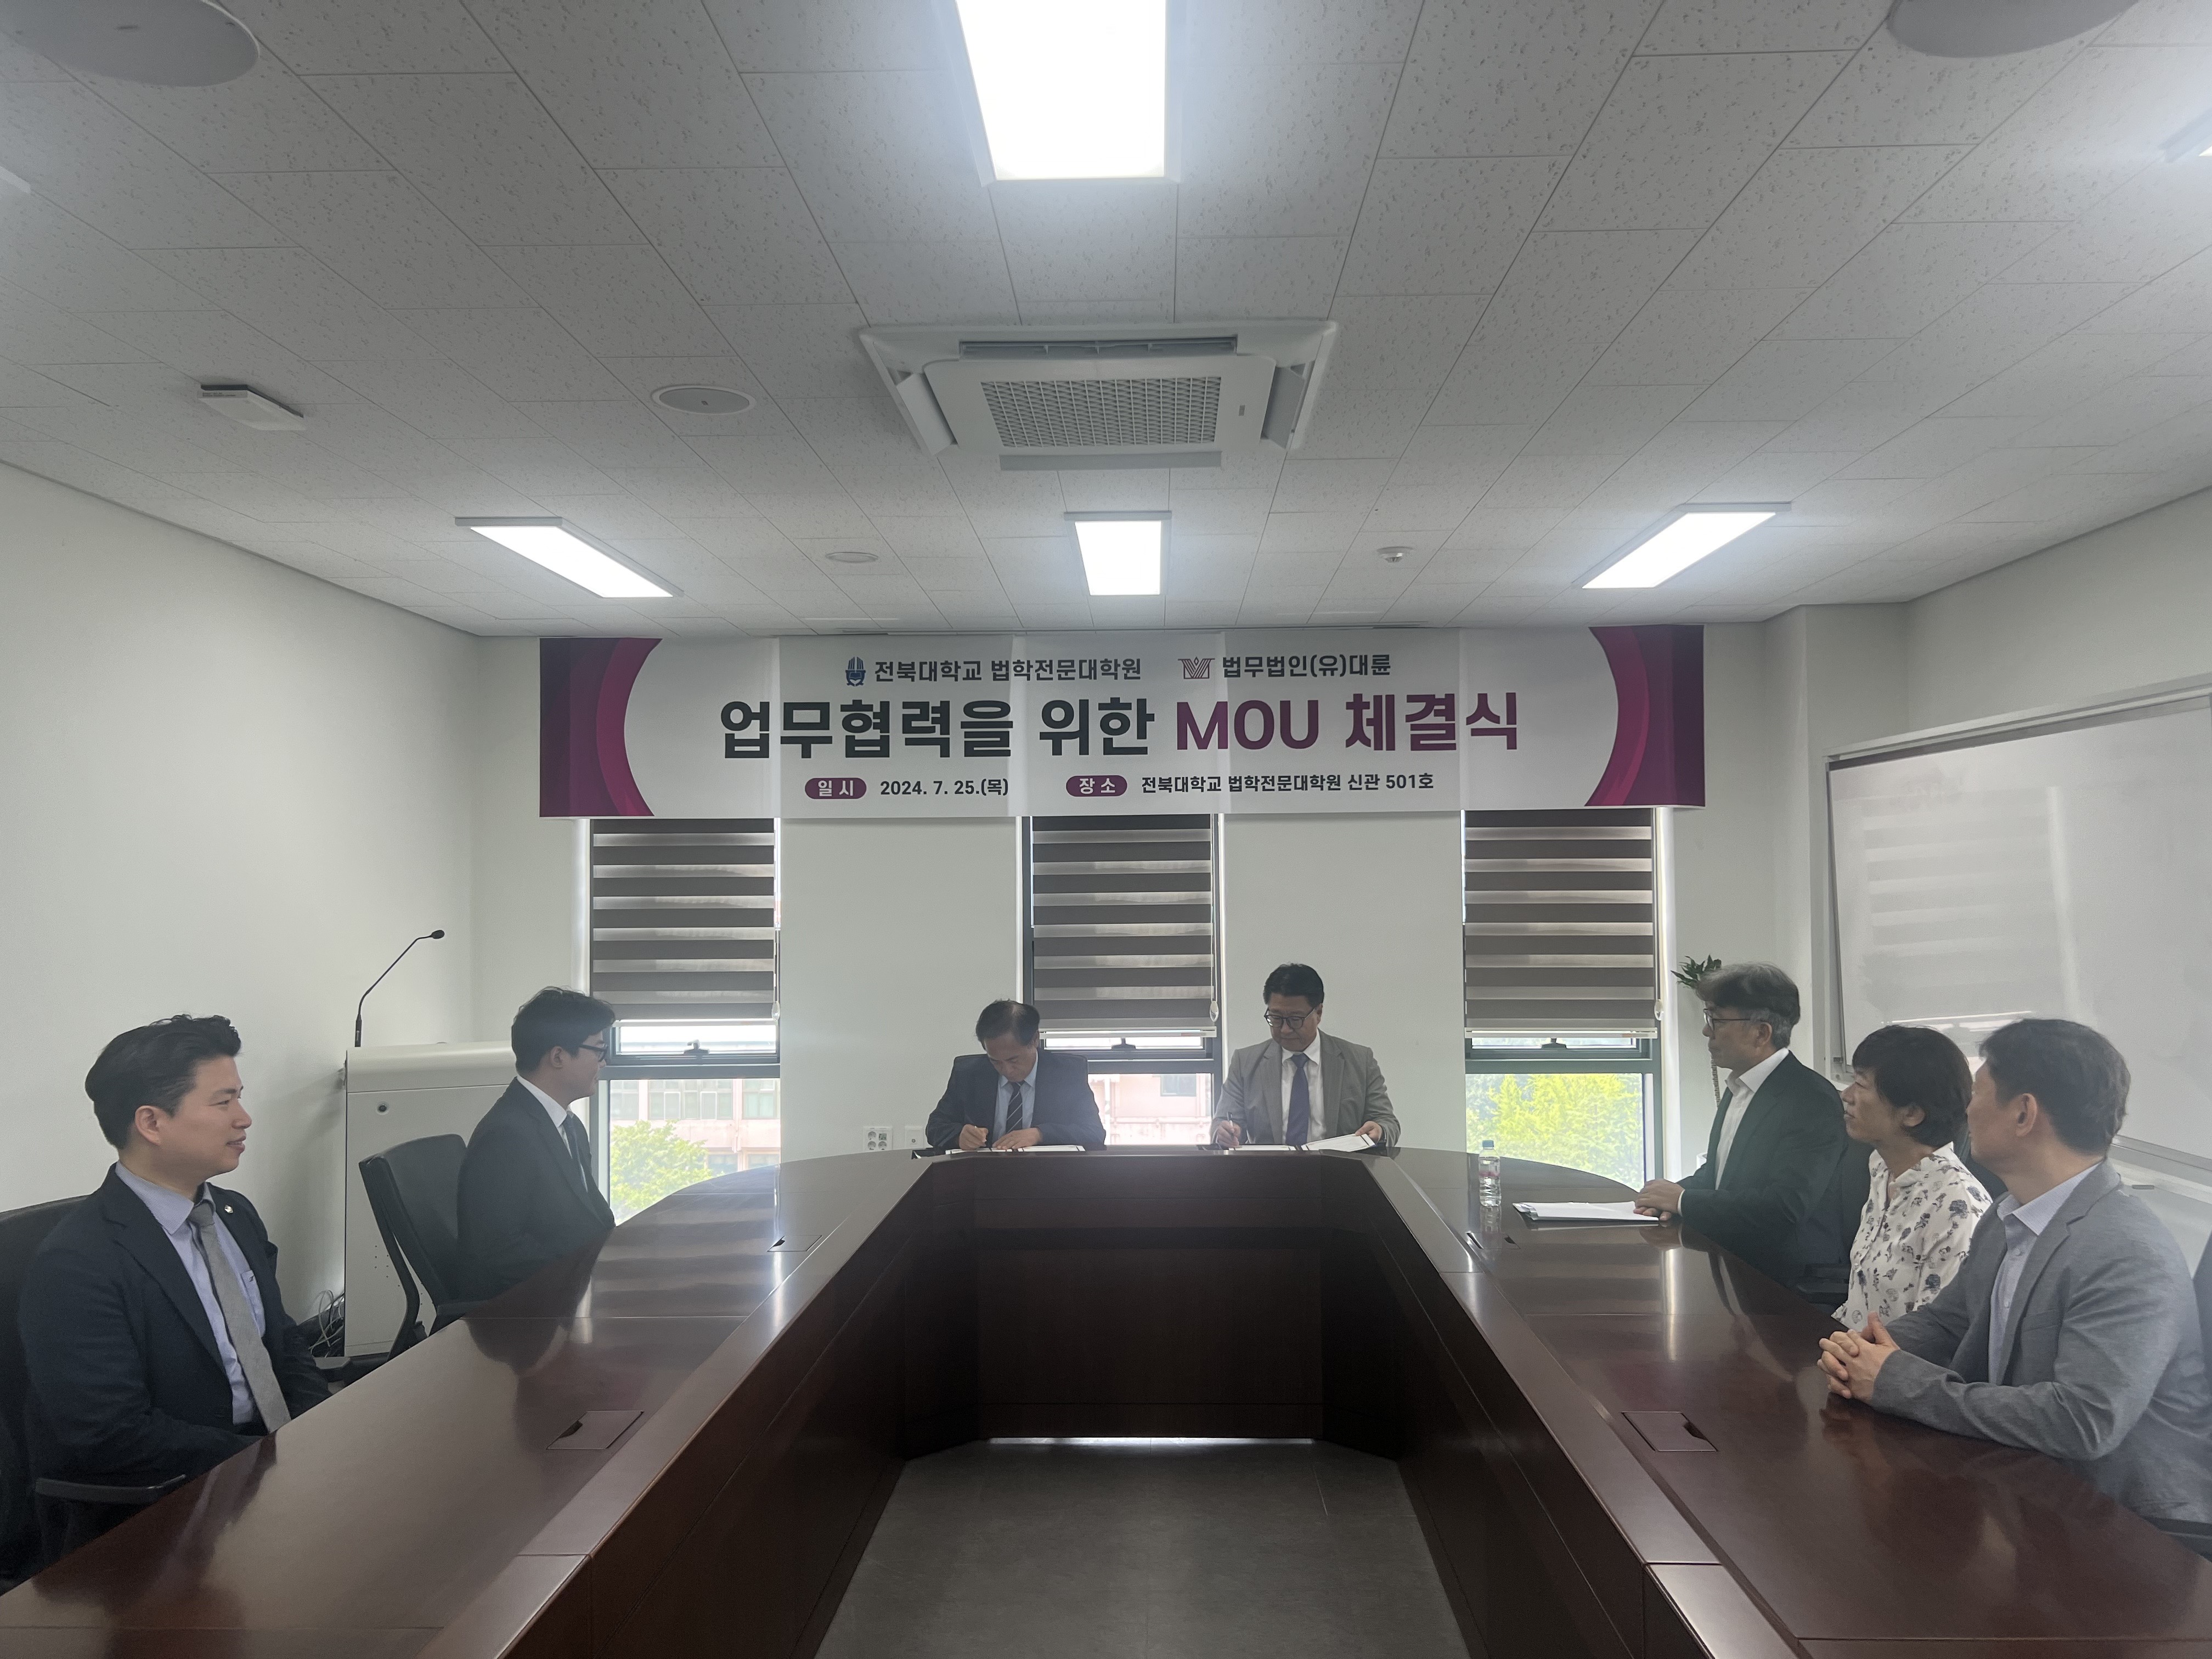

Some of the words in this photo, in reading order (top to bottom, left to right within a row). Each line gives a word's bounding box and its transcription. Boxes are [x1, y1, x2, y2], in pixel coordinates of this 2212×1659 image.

[874, 659, 982, 682] 전북대학교
[991, 658, 1141, 681] 법학전문대학원
[1222, 654, 1391, 678] 법무법인(유)대륜
[720, 699, 1014, 759] 업무협력을
[1039, 697, 1155, 756] 위한
[1176, 699, 1319, 751] MOU
[1345, 692, 1517, 751] 체결식
[880, 780, 927, 795] 2024.
[933, 780, 948, 795] 7.
[953, 778, 1009, 797] 25.(목)
[1142, 776, 1222, 793] 전북대학교
[1228, 774, 1341, 792] 법학전문대학원
[1347, 774, 1380, 791] 신관
[1386, 772, 1434, 789] 501호
